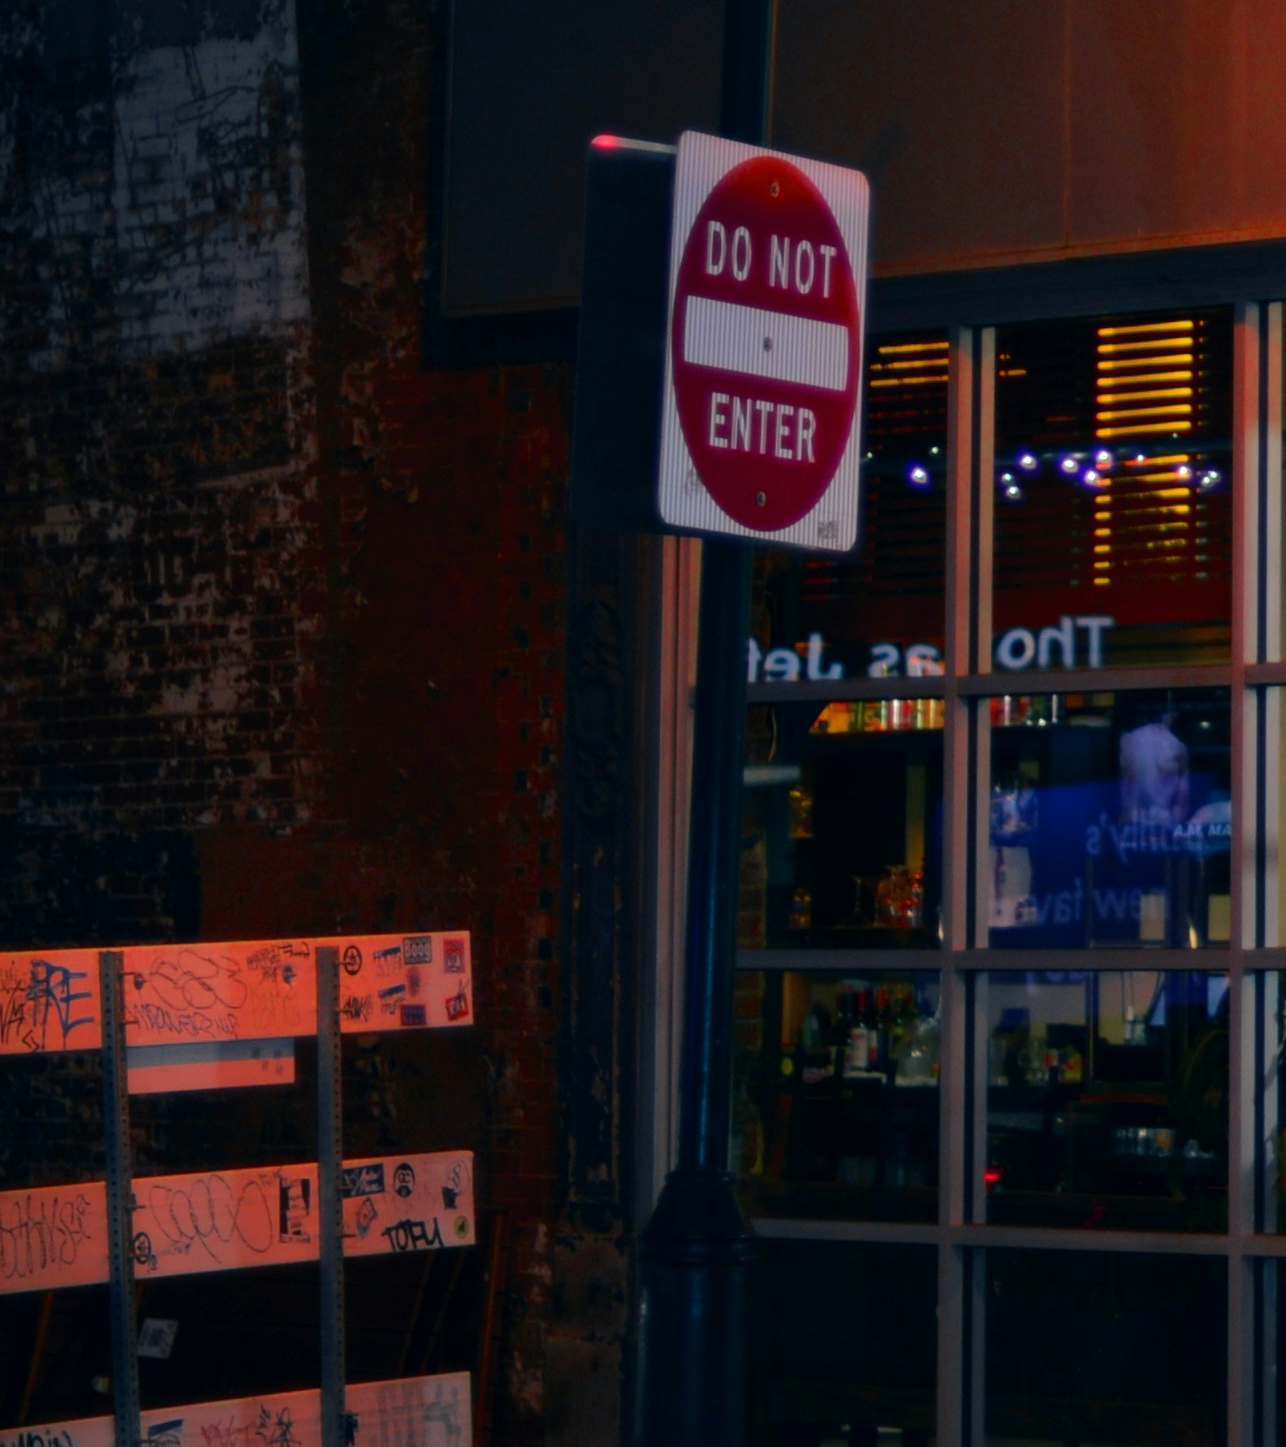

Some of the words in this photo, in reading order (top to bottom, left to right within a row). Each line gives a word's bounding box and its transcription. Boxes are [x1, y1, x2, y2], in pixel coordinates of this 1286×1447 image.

[705, 219, 753, 282] DO
[768, 234, 838, 300] NOT
[708, 391, 816, 464] ENTER
